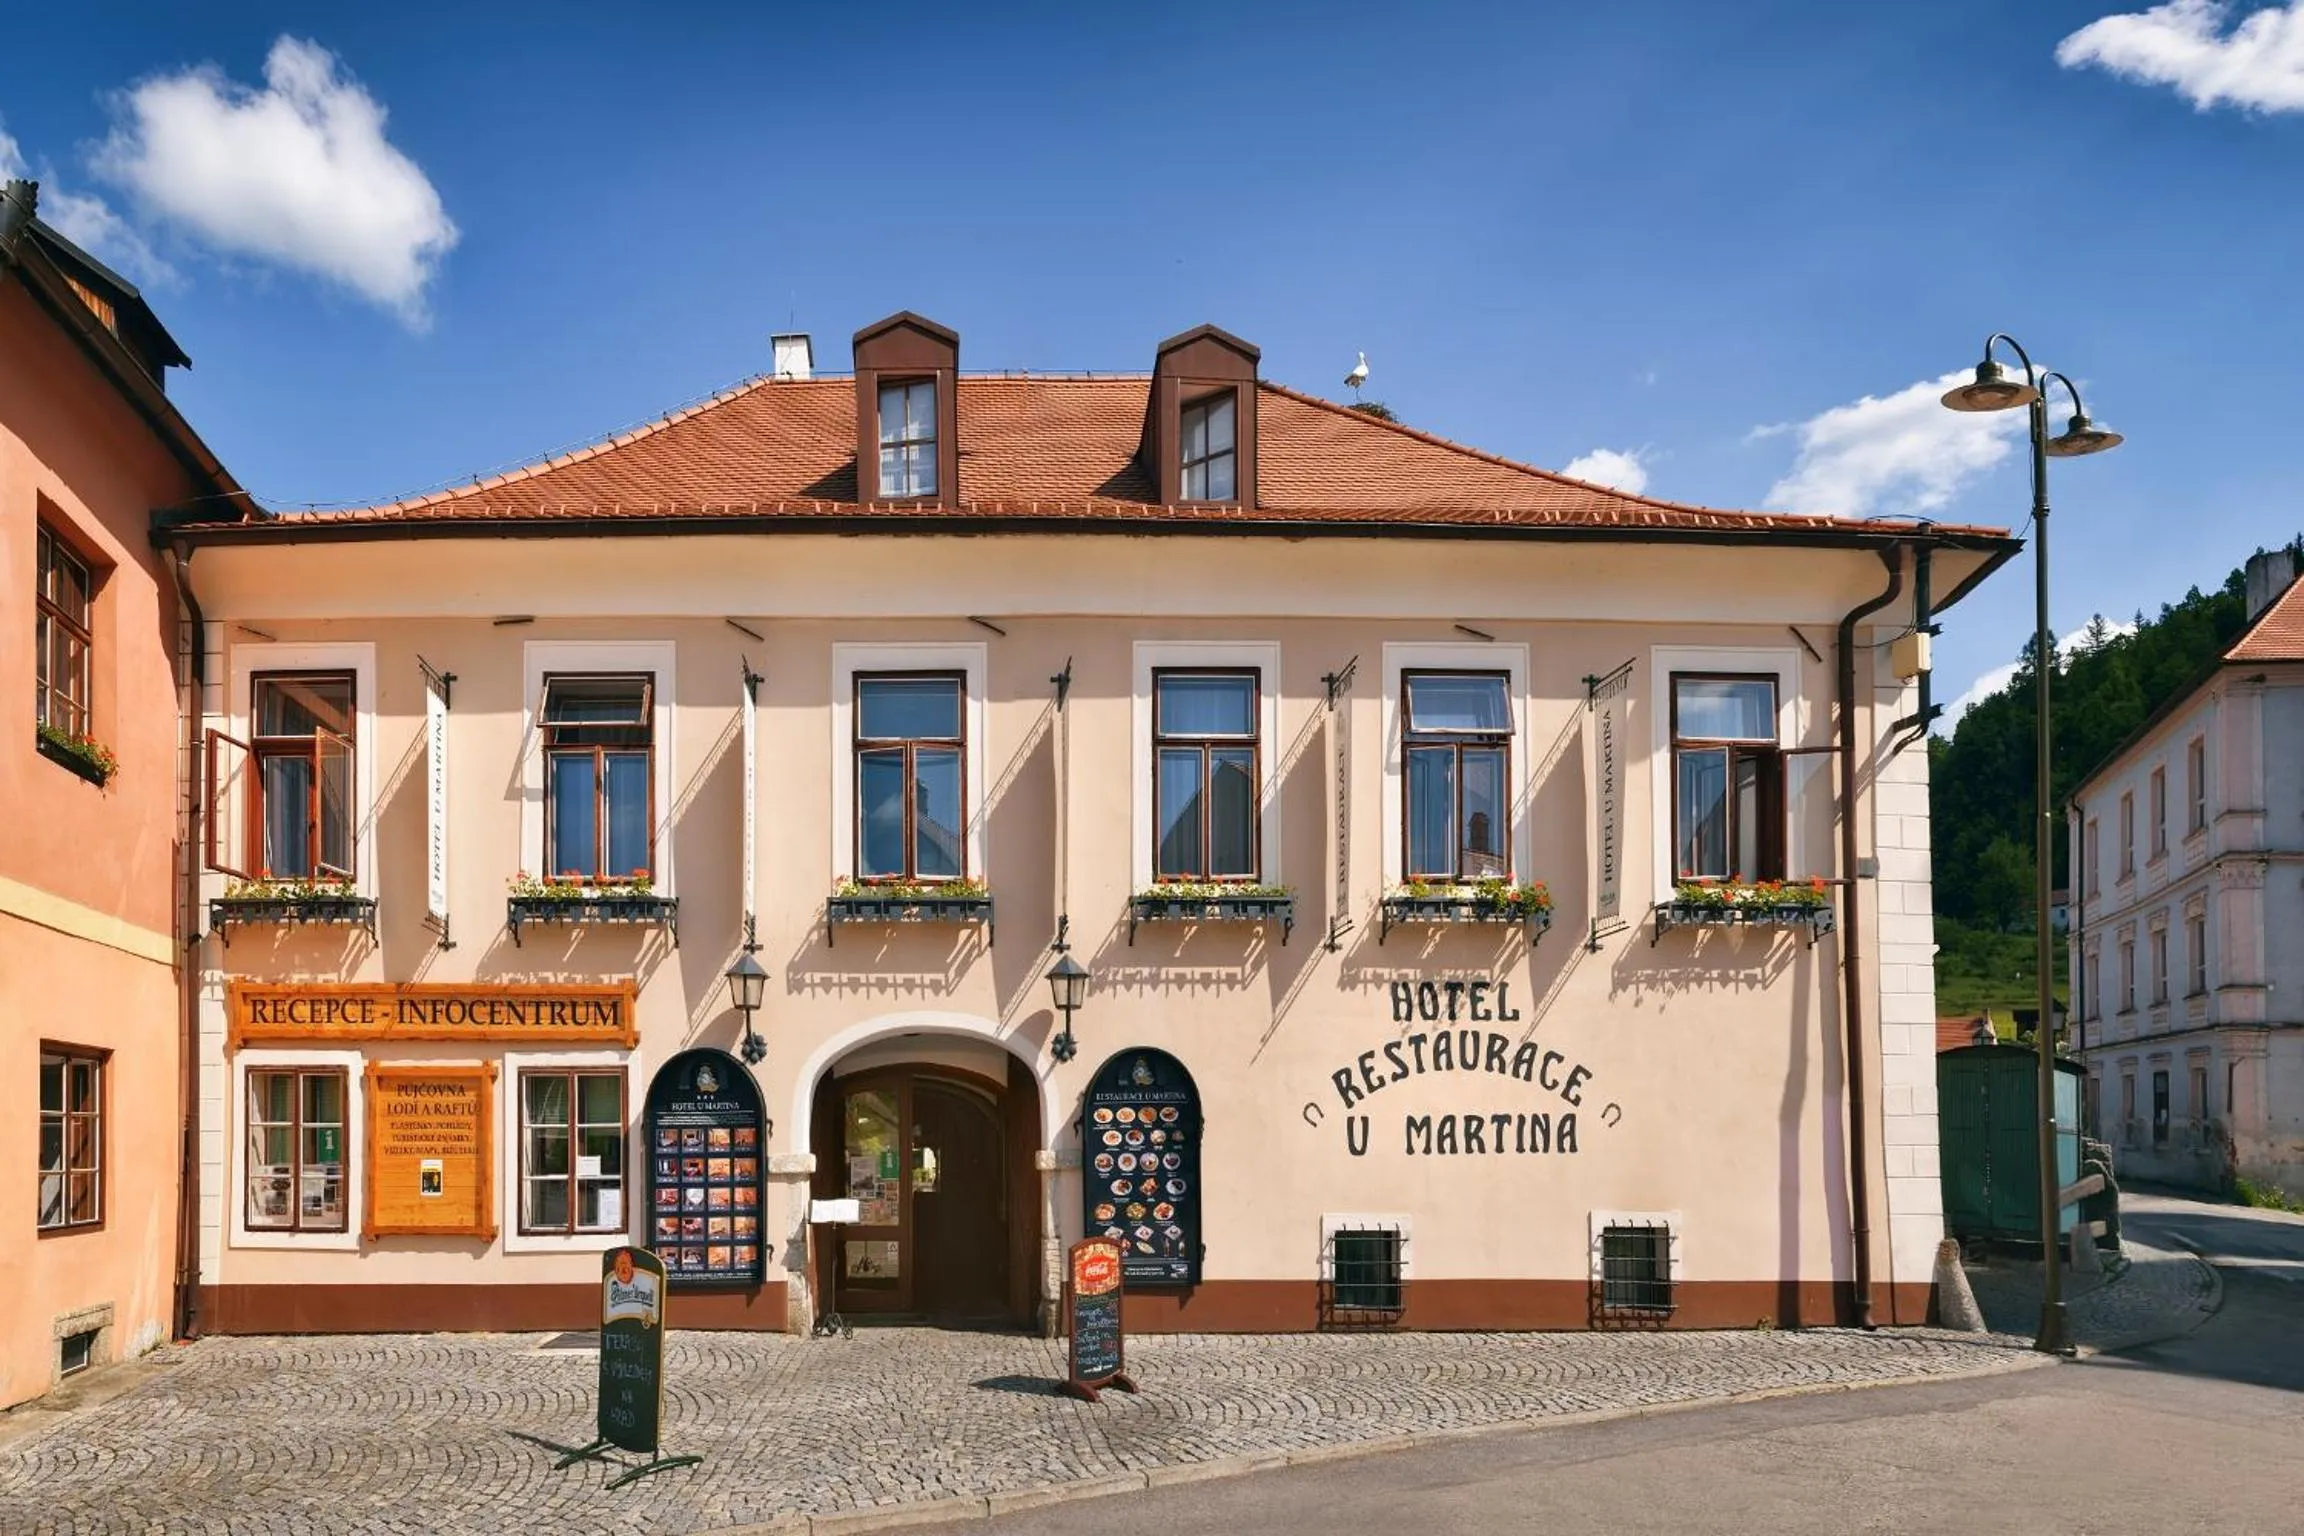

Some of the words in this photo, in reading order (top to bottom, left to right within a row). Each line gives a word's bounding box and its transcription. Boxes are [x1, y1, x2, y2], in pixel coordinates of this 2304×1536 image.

[1603, 710, 1614, 794] MARTINA
[433, 823, 442, 883] HOTEL
[1603, 818, 1614, 883] HOTEL
[251, 999, 375, 1024] RECEPCE
[398, 999, 618, 1026] INFOCENTRUM
[1391, 981, 1519, 1022] HOTEL
[1331, 1030, 1593, 1109] RESTAURACE
[671, 1102, 696, 1111] HOTEL
[1346, 1115, 1369, 1156] U
[1406, 1113, 1579, 1156] MARTINA
